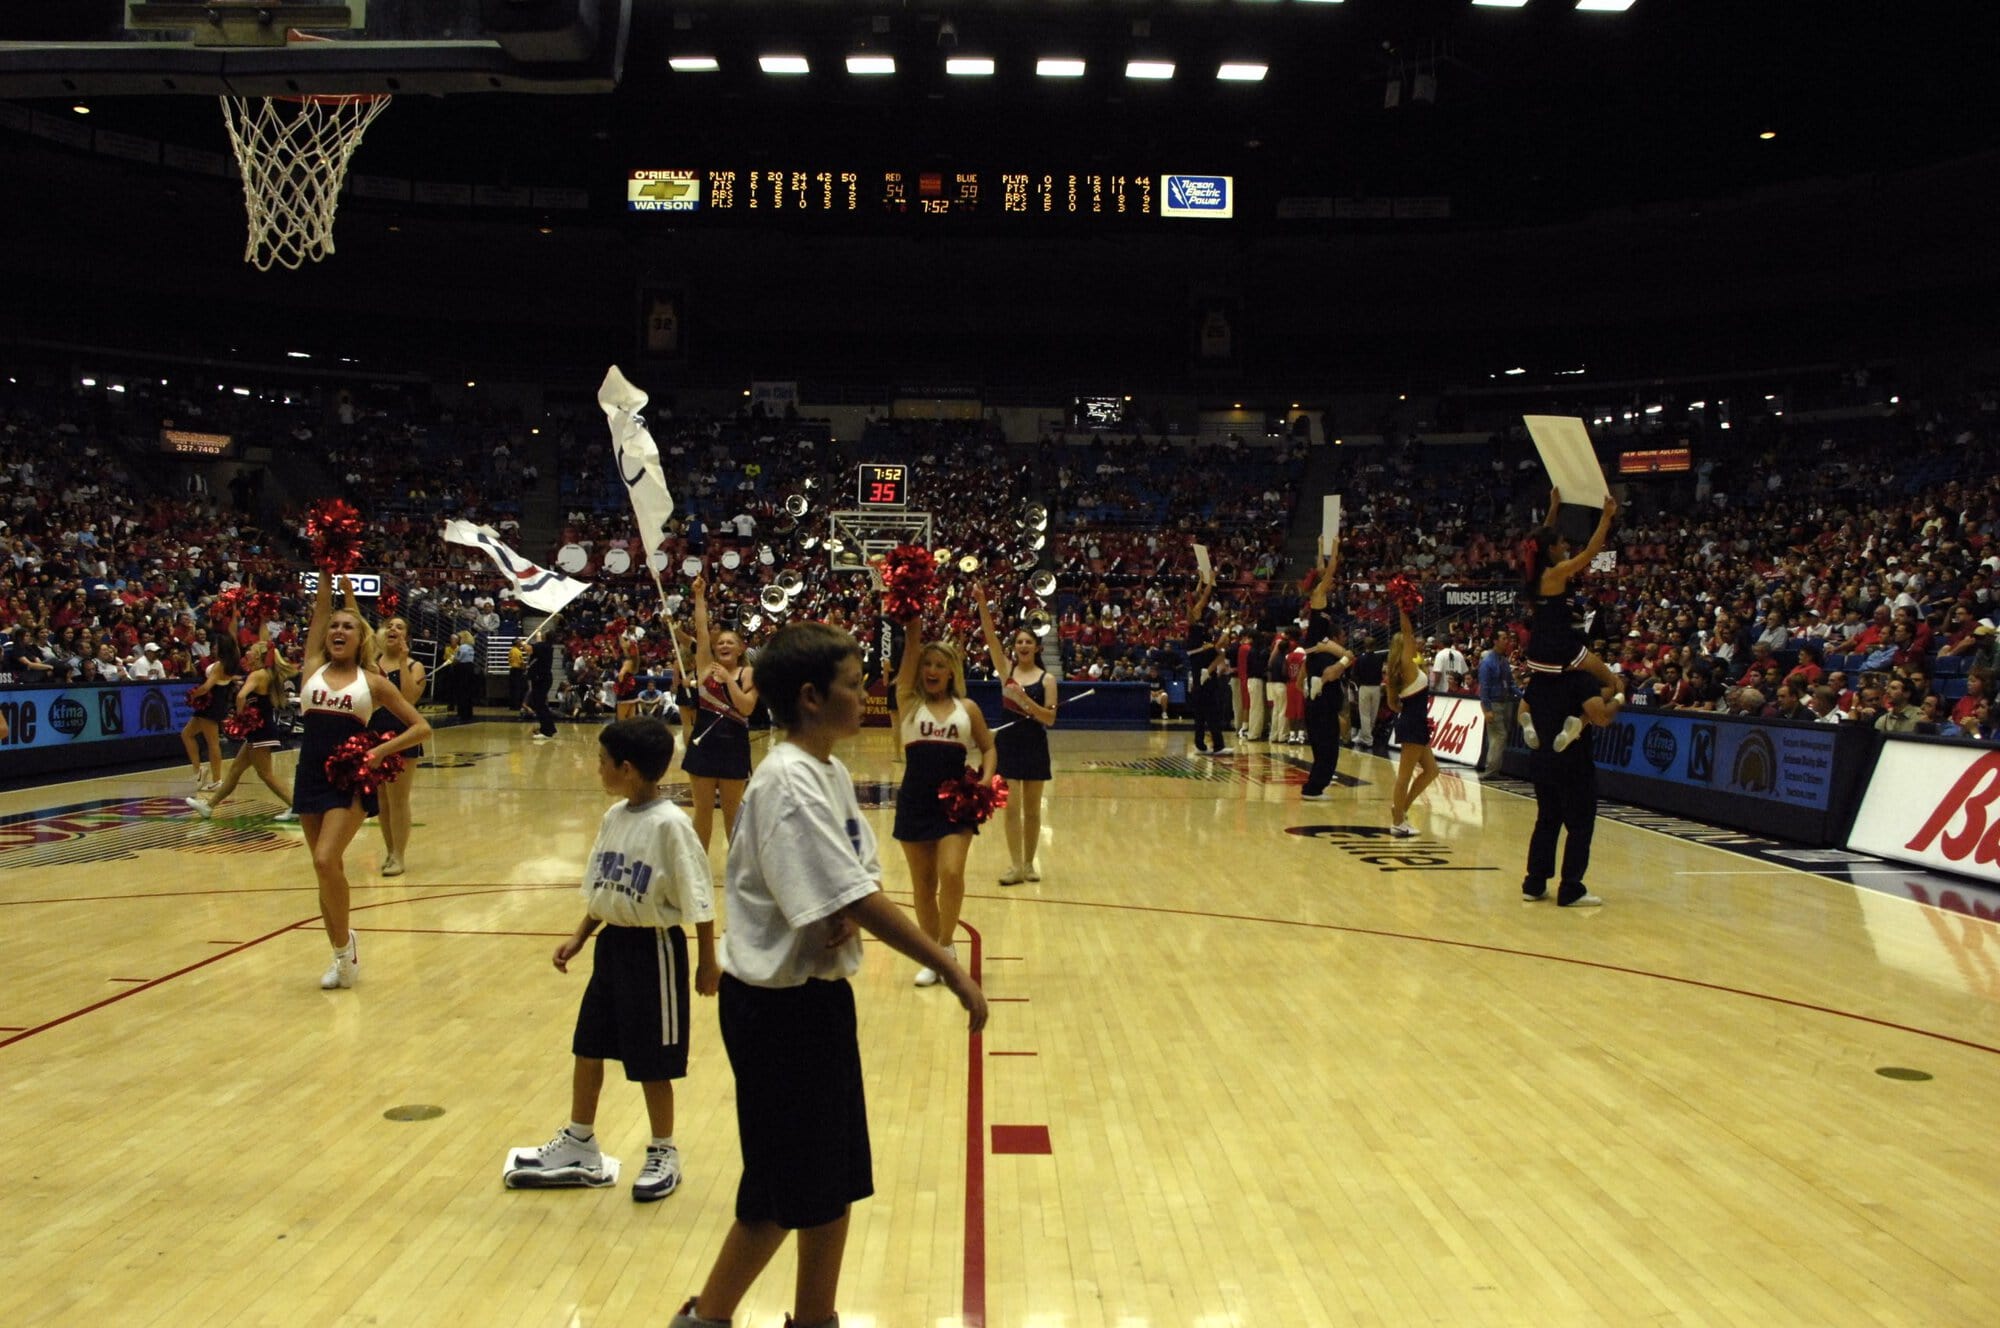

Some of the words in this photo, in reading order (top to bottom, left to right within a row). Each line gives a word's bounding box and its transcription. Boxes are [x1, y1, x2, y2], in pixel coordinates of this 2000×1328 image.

[634, 170, 694, 179] O'RIELLY
[709, 171, 736, 181] PLYR
[767, 171, 783, 181] 20
[792, 171, 808, 181] 34
[817, 172, 832, 182] 42
[841, 173, 857, 182] 50
[885, 172, 902, 182] RED
[956, 174, 978, 182] BLUE
[1002, 174, 1028, 184] PLYR
[1087, 175, 1101, 185] 12
[1112, 176, 1126, 185] 14
[1135, 176, 1150, 185] 44
[714, 180, 733, 190] PTS
[1007, 183, 1026, 193] PTS
[1038, 184, 1052, 193] 17
[1112, 184, 1123, 194] 11
[1182, 180, 1215, 189] Tucson
[712, 190, 733, 199] RBS
[886, 184, 903, 197] 54
[960, 185, 978, 198] 59
[1185, 188, 1221, 197] Electric
[1005, 193, 1027, 202] RBS
[1188, 196, 1222, 205] Power
[634, 201, 694, 210] WATSON
[711, 199, 733, 208] FLS
[920, 200, 950, 213] 7:52
[1005, 202, 1027, 212] FLS
[873, 468, 902, 481] 7:52
[869, 483, 896, 501] 35
[1446, 591, 1488, 605] MUSCLE
